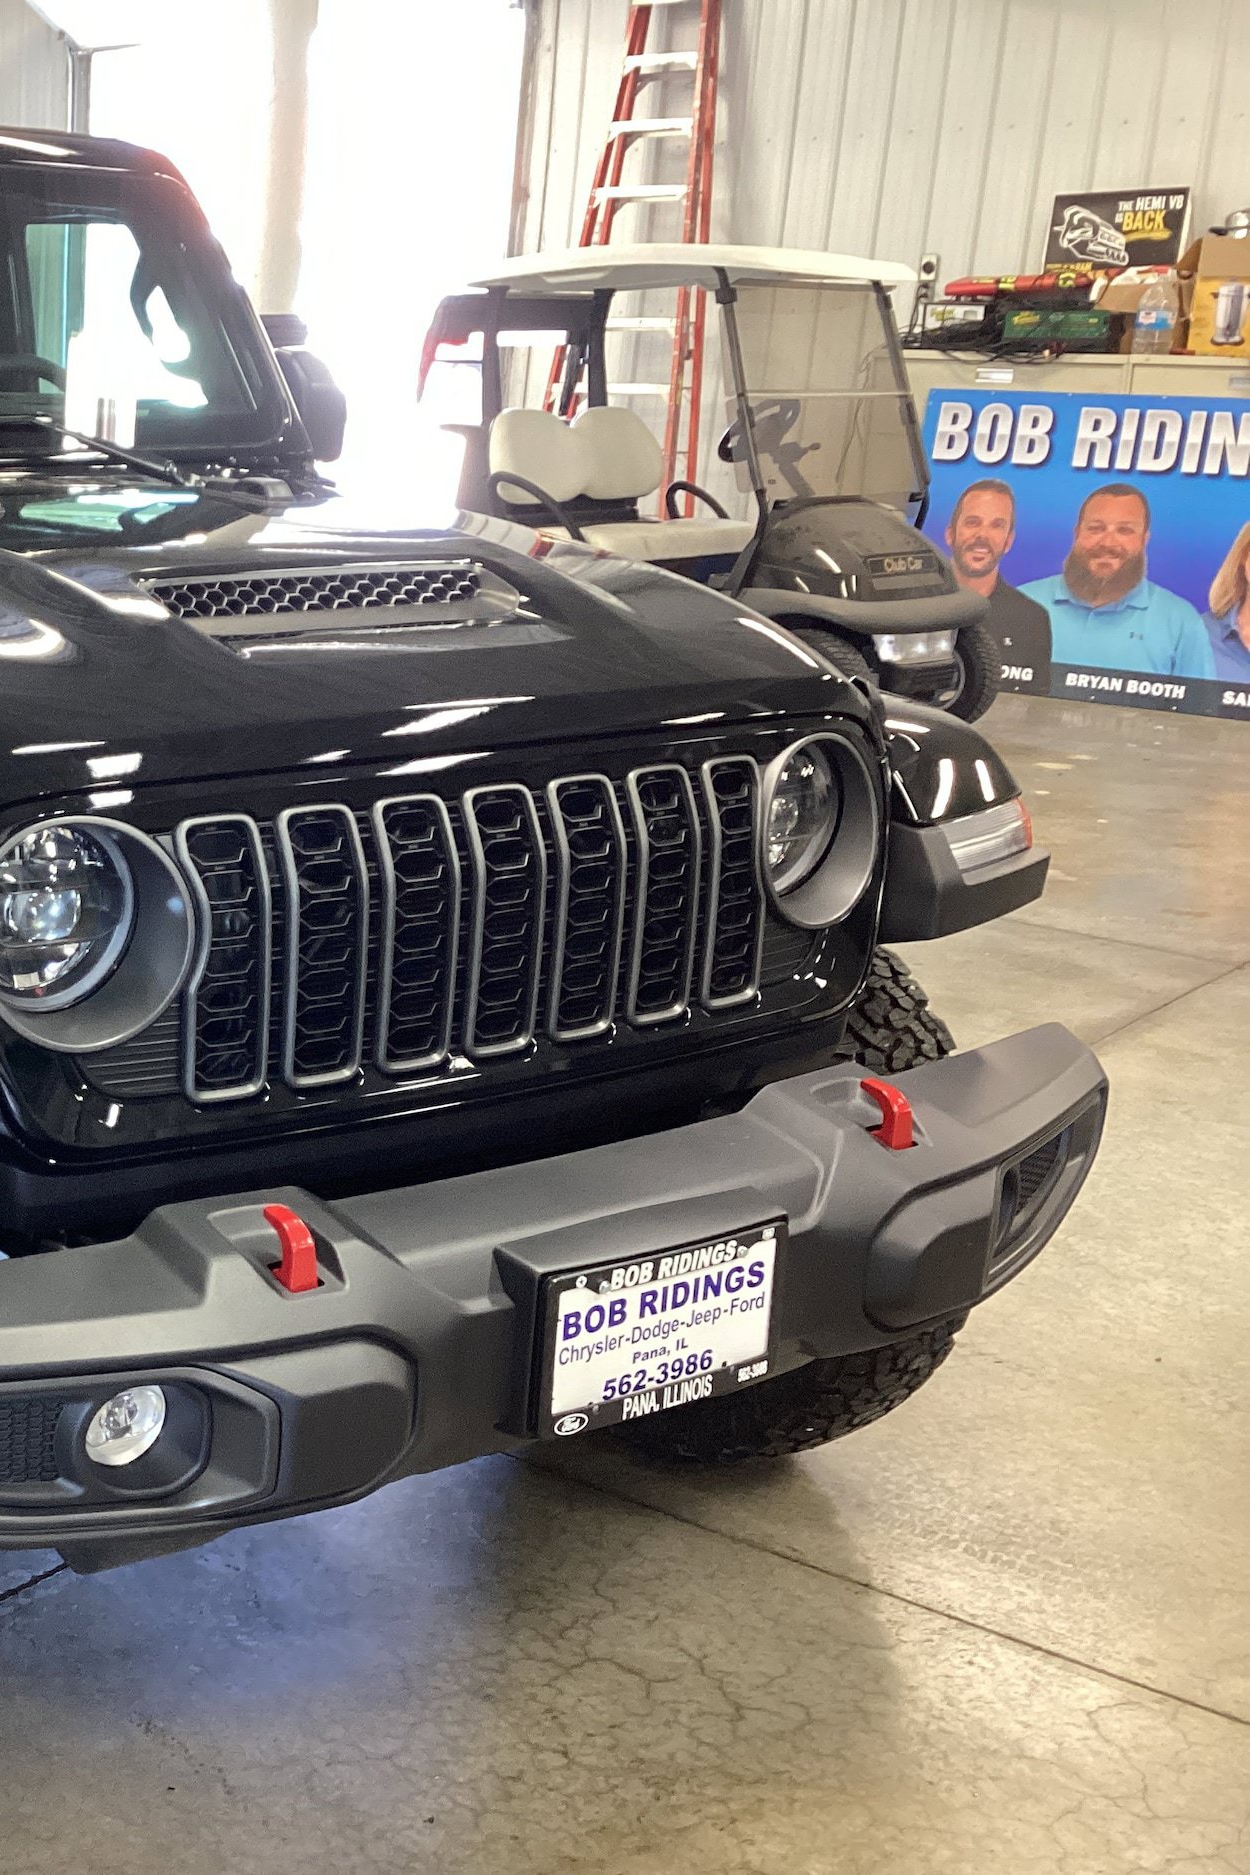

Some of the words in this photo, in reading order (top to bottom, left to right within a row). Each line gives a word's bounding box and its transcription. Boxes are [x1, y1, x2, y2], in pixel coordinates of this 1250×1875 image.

[1118, 200, 1134, 212] THE
[1135, 195, 1166, 212] HEMI
[1169, 194, 1184, 210] V8
[1122, 209, 1166, 232] BACK
[932, 402, 1054, 465] BOB
[1065, 672, 1123, 692] BRYAN
[1126, 679, 1186, 700] BOOTH
[1222, 690, 1250, 708] SA
[611, 1261, 654, 1291] BOB
[658, 1240, 738, 1279] RIDINGS
[562, 1298, 627, 1341] BOB
[640, 1261, 766, 1319] RIDINGS
[559, 1292, 765, 1365] Chrysler-Dodge-Jeep-Ford
[632, 1347, 670, 1364] Pana,
[676, 1337, 688, 1350] IL
[602, 1349, 713, 1401] 562-3986
[662, 1374, 713, 1410] ILLINOIS
